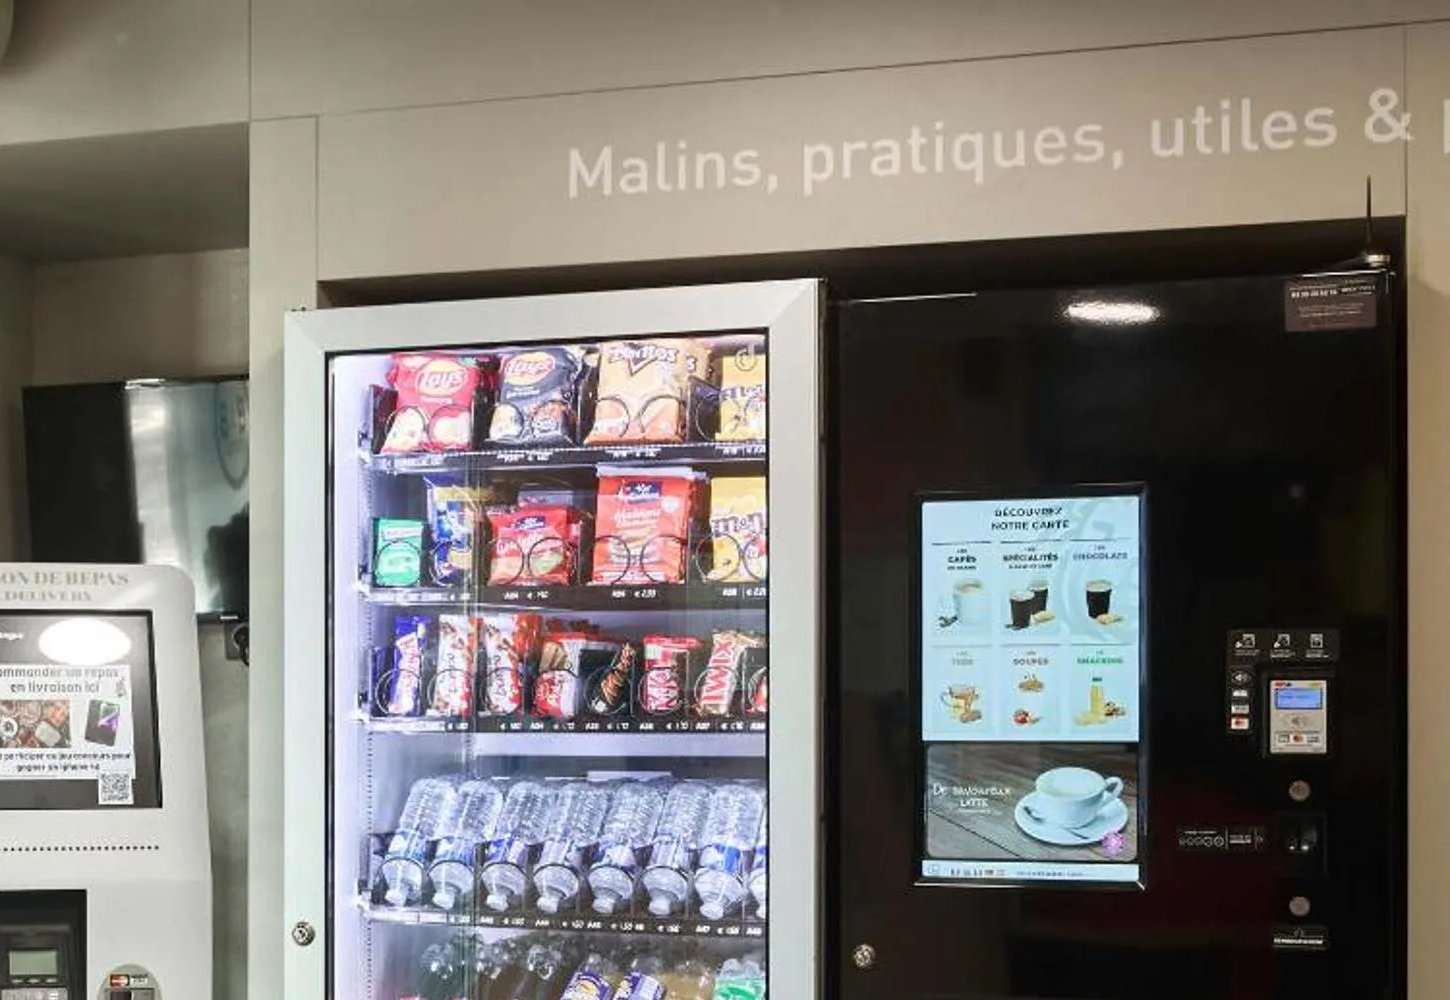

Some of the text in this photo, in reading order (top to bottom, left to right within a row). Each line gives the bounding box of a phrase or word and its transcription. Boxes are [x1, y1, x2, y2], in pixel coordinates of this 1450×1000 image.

[566, 142, 779, 198] Malins,
[801, 121, 1126, 195] pratiques,
[1150, 98, 1338, 159] utiles
[1363, 87, 1414, 144] &
[33, 572, 63, 585] DE
[65, 573, 130, 586] REPAS
[28, 681, 83, 693] livraison
[701, 641, 736, 702] TWIX
